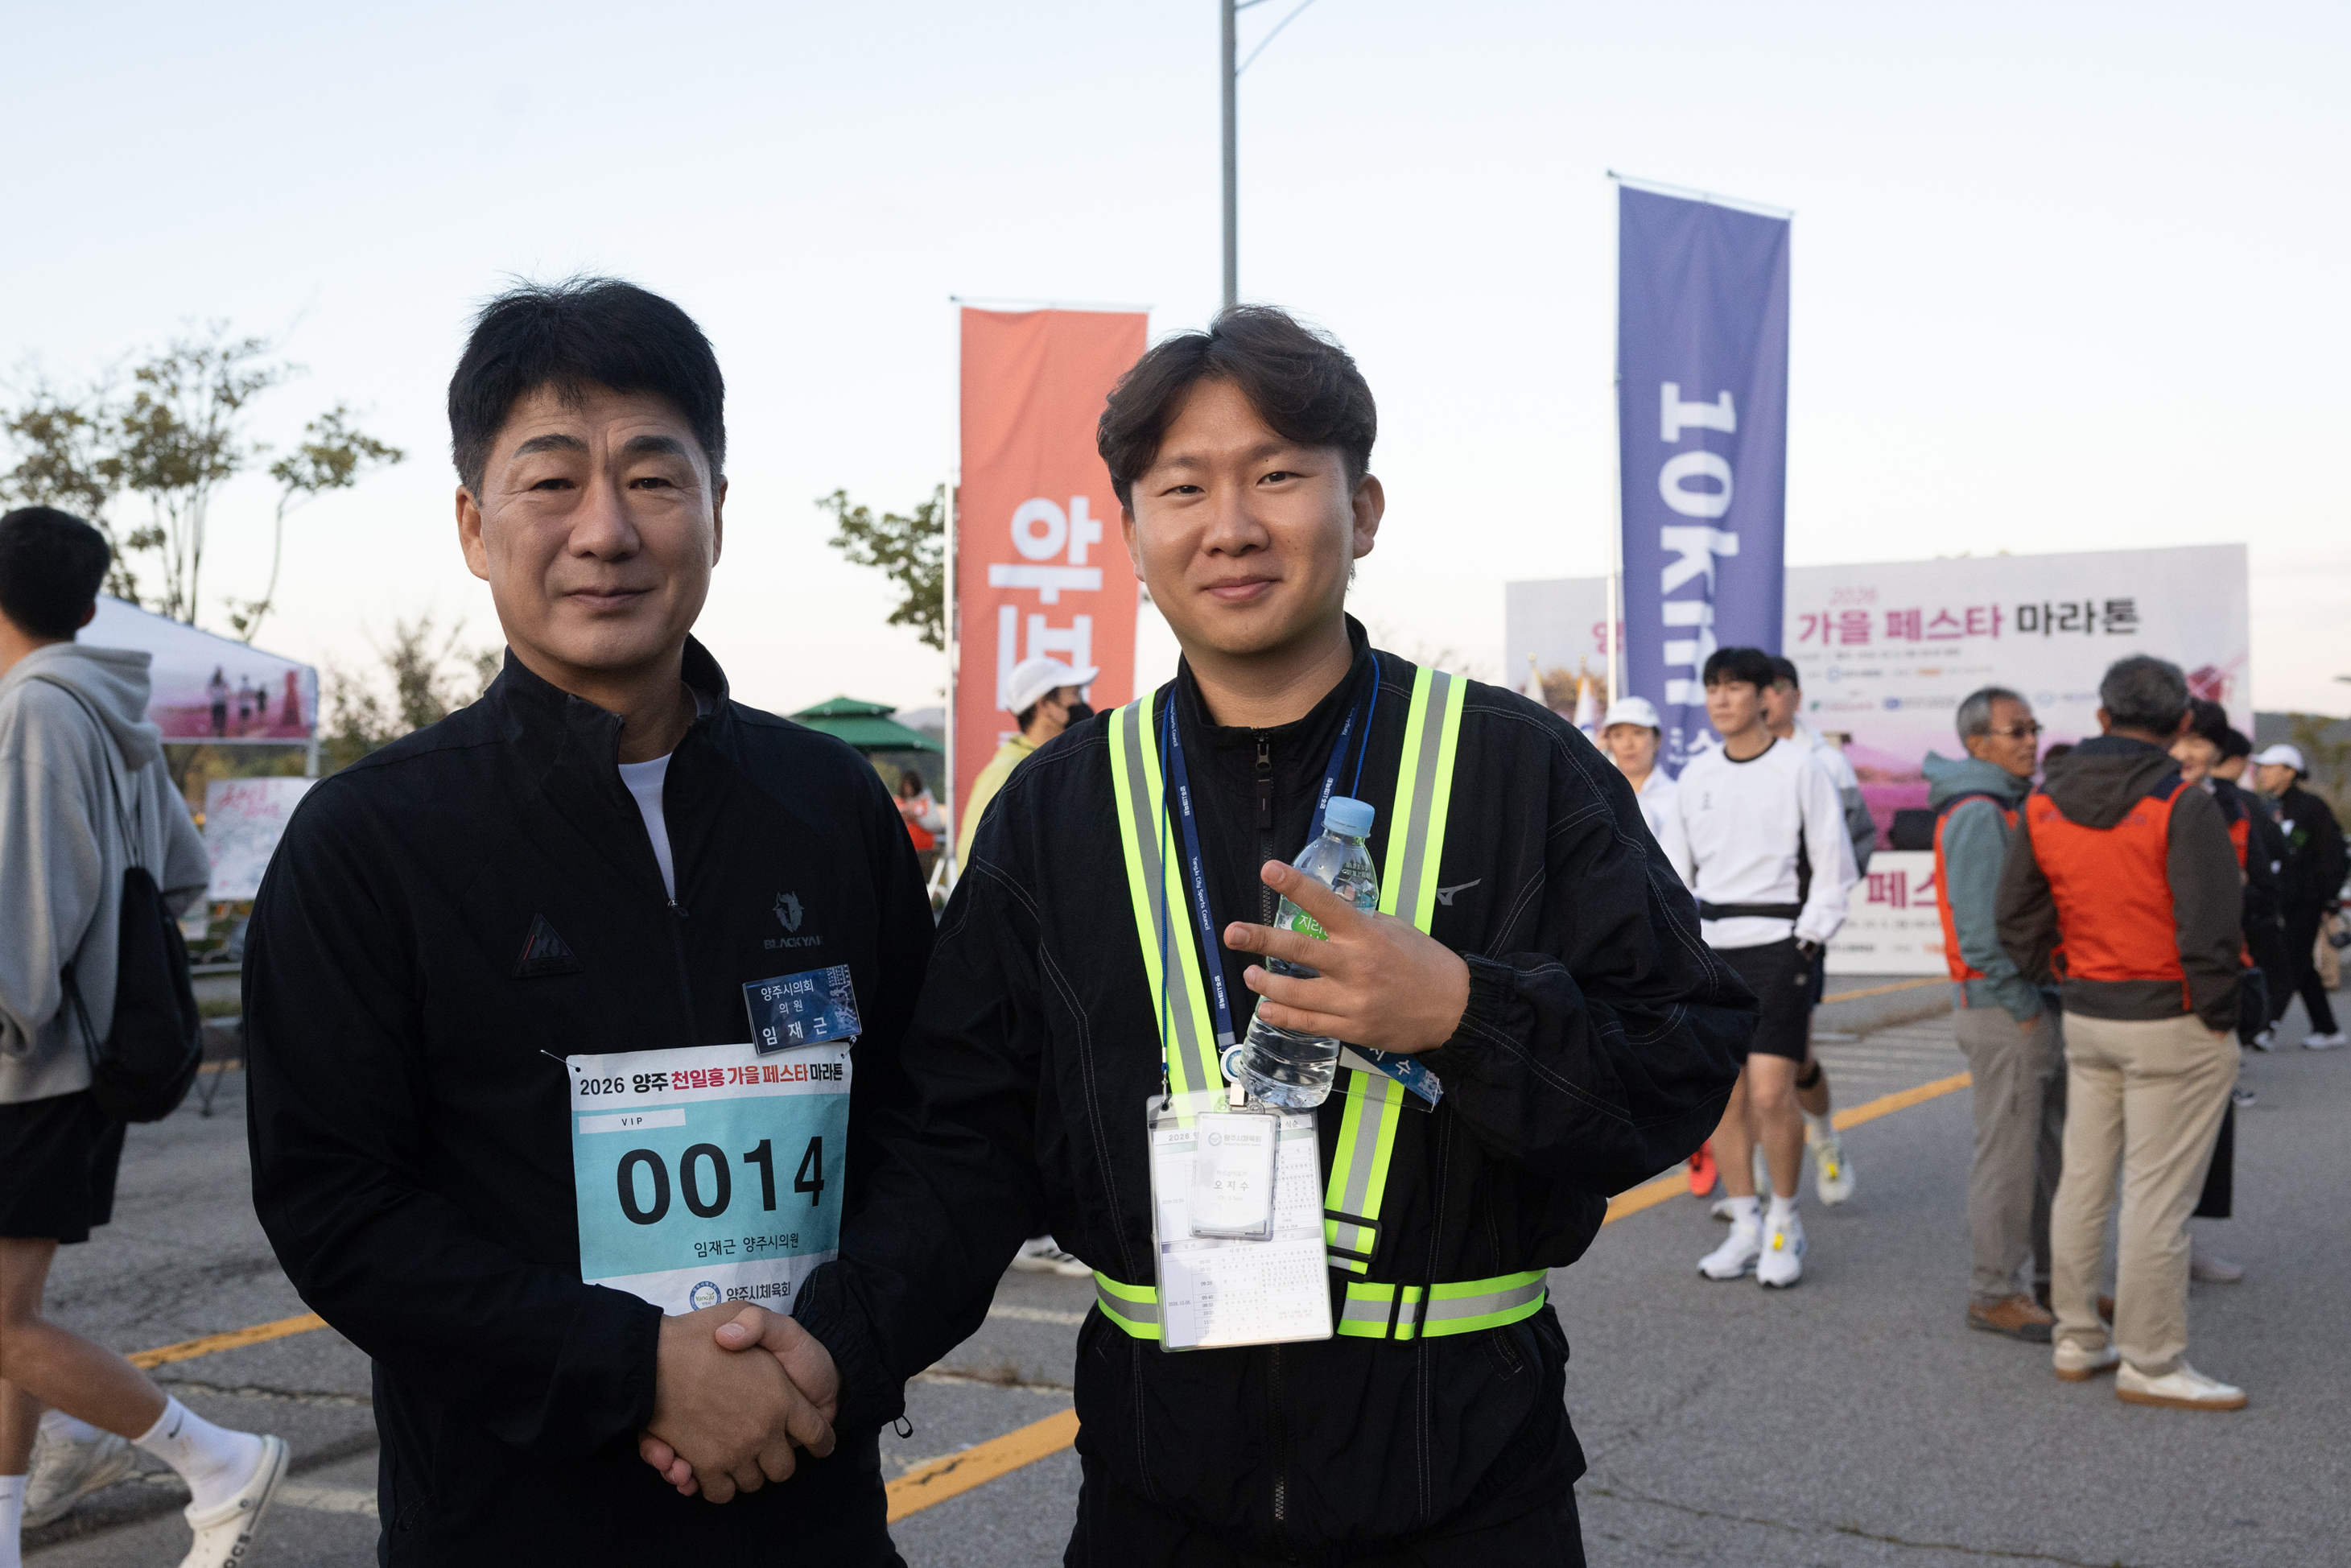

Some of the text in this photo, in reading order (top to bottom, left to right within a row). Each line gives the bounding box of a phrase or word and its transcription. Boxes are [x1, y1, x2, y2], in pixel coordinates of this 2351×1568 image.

[1659, 382, 1739, 705] 10km
[1799, 606, 1873, 646] 가을
[1884, 604, 2004, 641] 페스타
[2017, 597, 2140, 636] 마라톤
[1197, 889, 1206, 910] Sports
[1202, 909, 1211, 930] Council
[1298, 914, 1328, 937] 지리
[761, 978, 815, 1001] 양주시의회
[580, 1063, 843, 1096] 2026 양주 천일홍 가을 페스타 마라톤
[621, 1116, 643, 1125] VIP
[1169, 1133, 1190, 1141] 2026
[1223, 1134, 1261, 1142] 양주시체육회
[617, 1136, 825, 1225] 0014
[694, 1232, 799, 1258] 임재근 양주시의원
[726, 1281, 790, 1302] 양주시체육회
